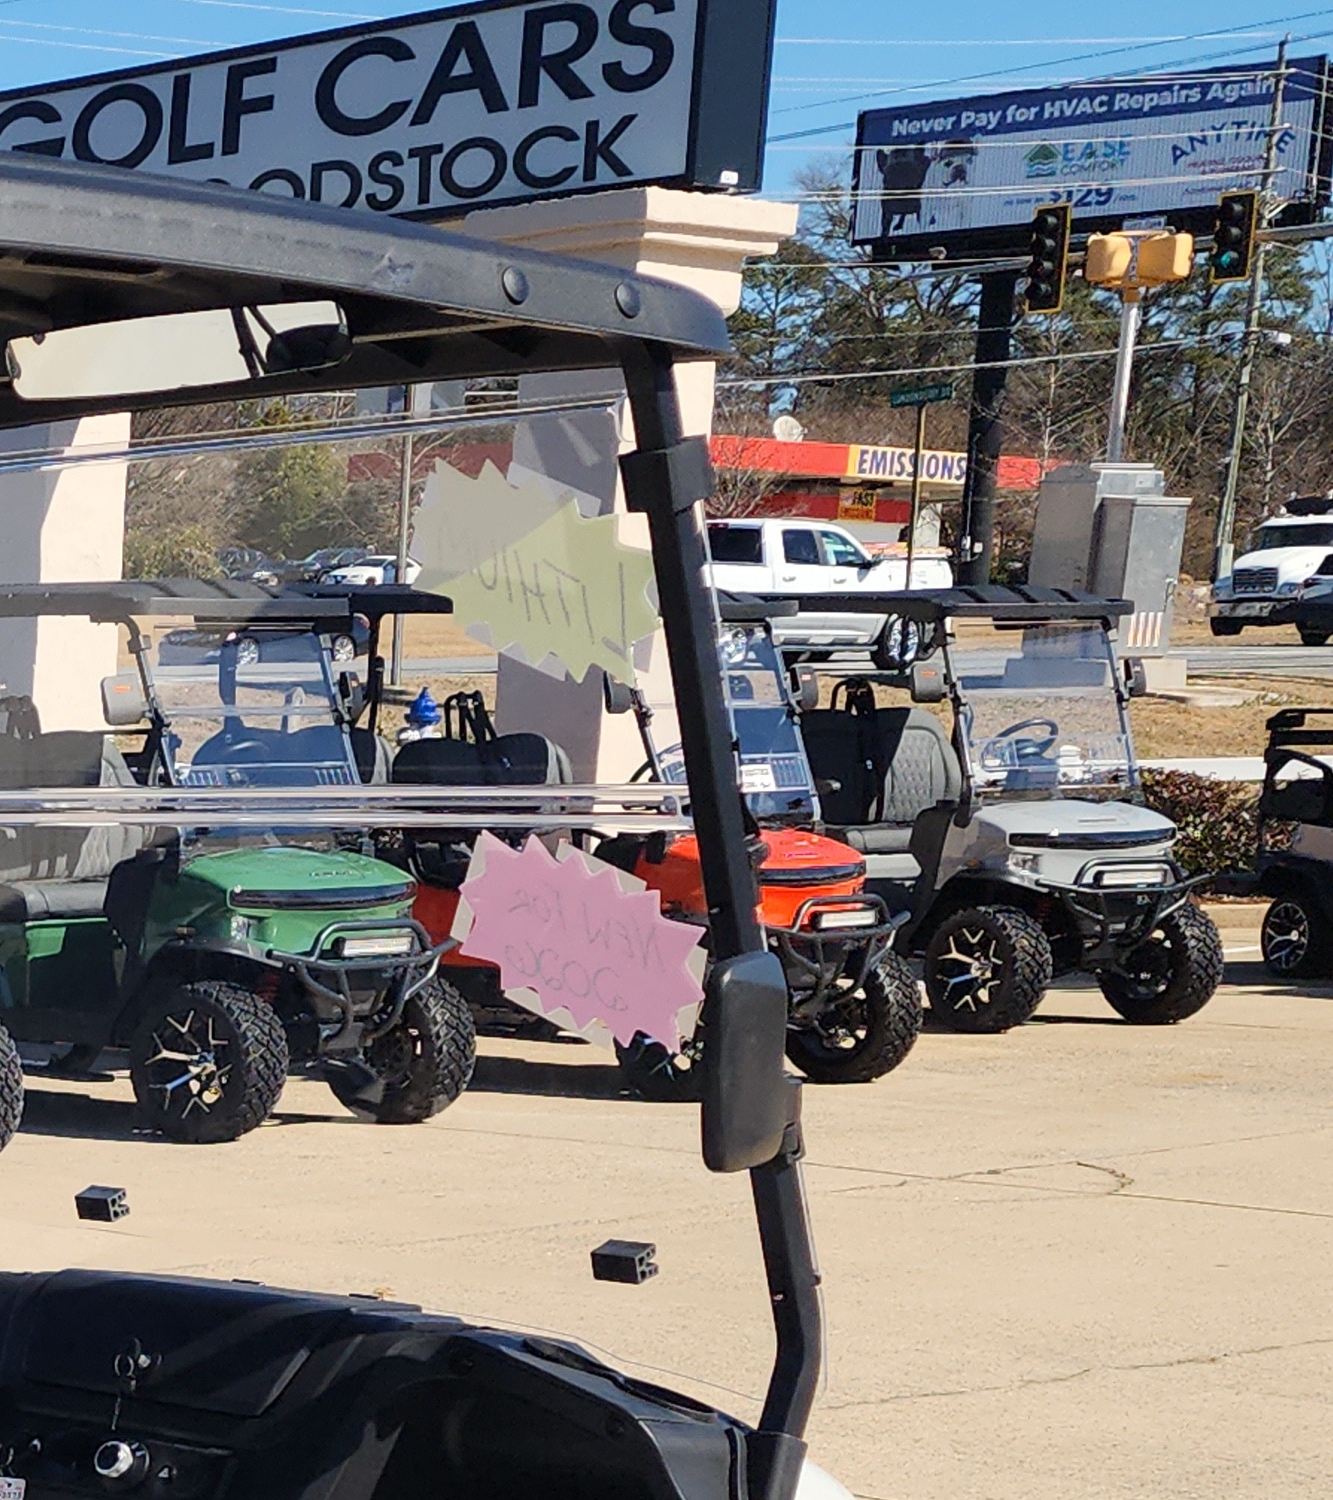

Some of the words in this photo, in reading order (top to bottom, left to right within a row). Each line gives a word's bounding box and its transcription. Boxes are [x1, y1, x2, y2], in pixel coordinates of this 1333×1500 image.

[314, 0, 676, 136] CARS
[891, 115, 957, 138] Never
[960, 110, 1001, 131] Pay
[1006, 105, 1041, 125] for
[1043, 94, 1109, 120] HVAC
[1115, 85, 1203, 116] Repairs
[207, 114, 638, 212] ODSTOCK
[1063, 135, 1130, 162] EASE
[857, 448, 967, 482] EMISSIONS
